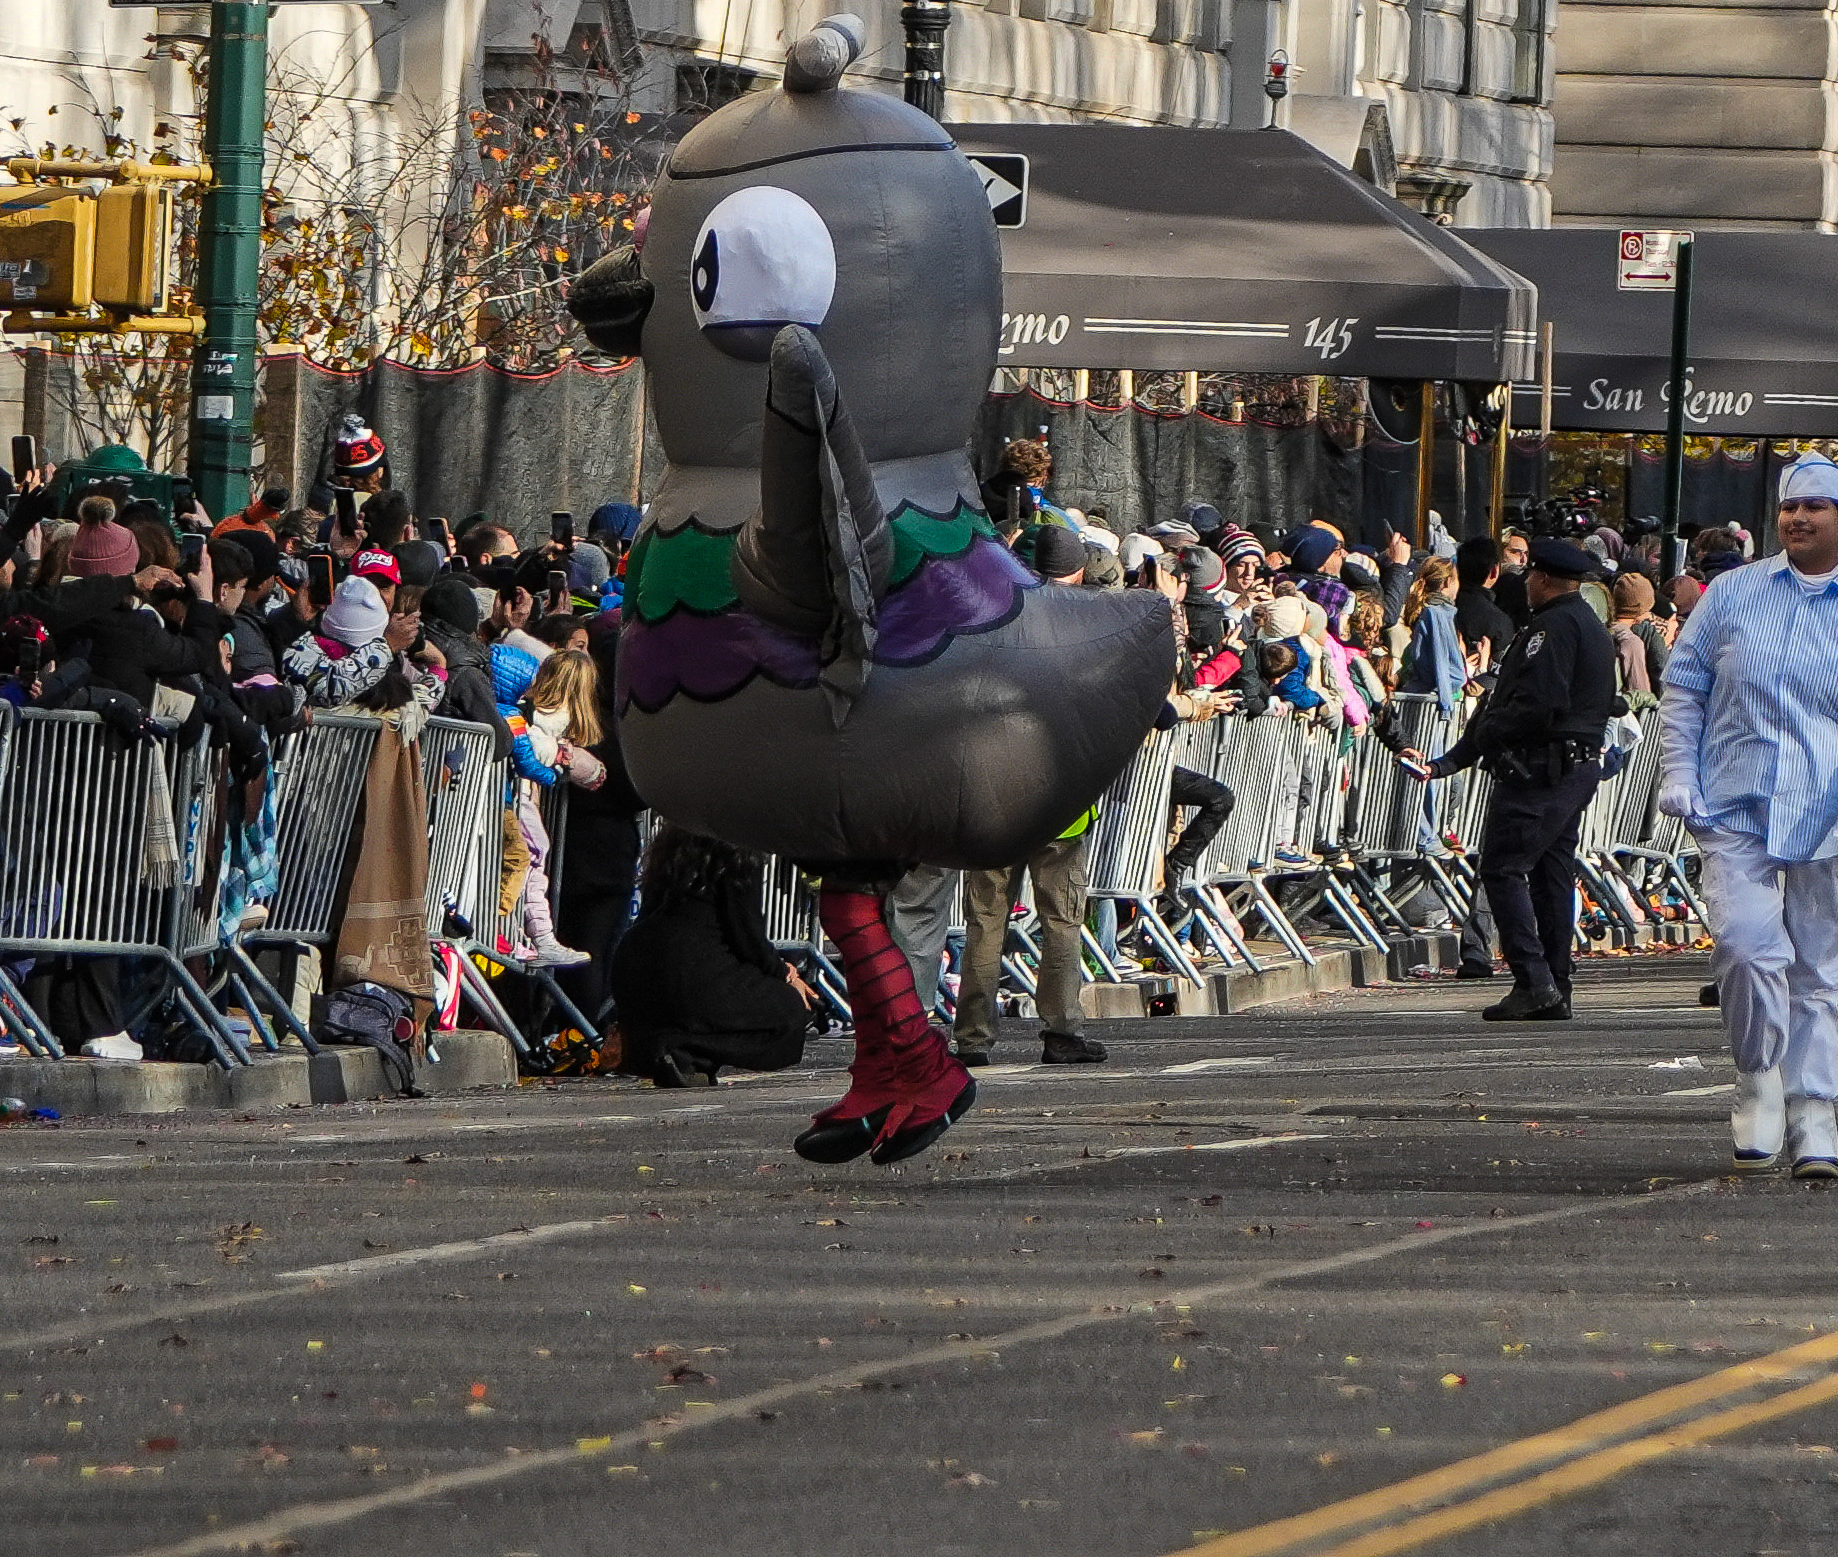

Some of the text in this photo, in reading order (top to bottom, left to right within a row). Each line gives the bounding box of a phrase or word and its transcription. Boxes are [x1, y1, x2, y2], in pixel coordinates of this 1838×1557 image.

[999, 312, 1359, 360] emo 145
[1583, 378, 1645, 411] San
